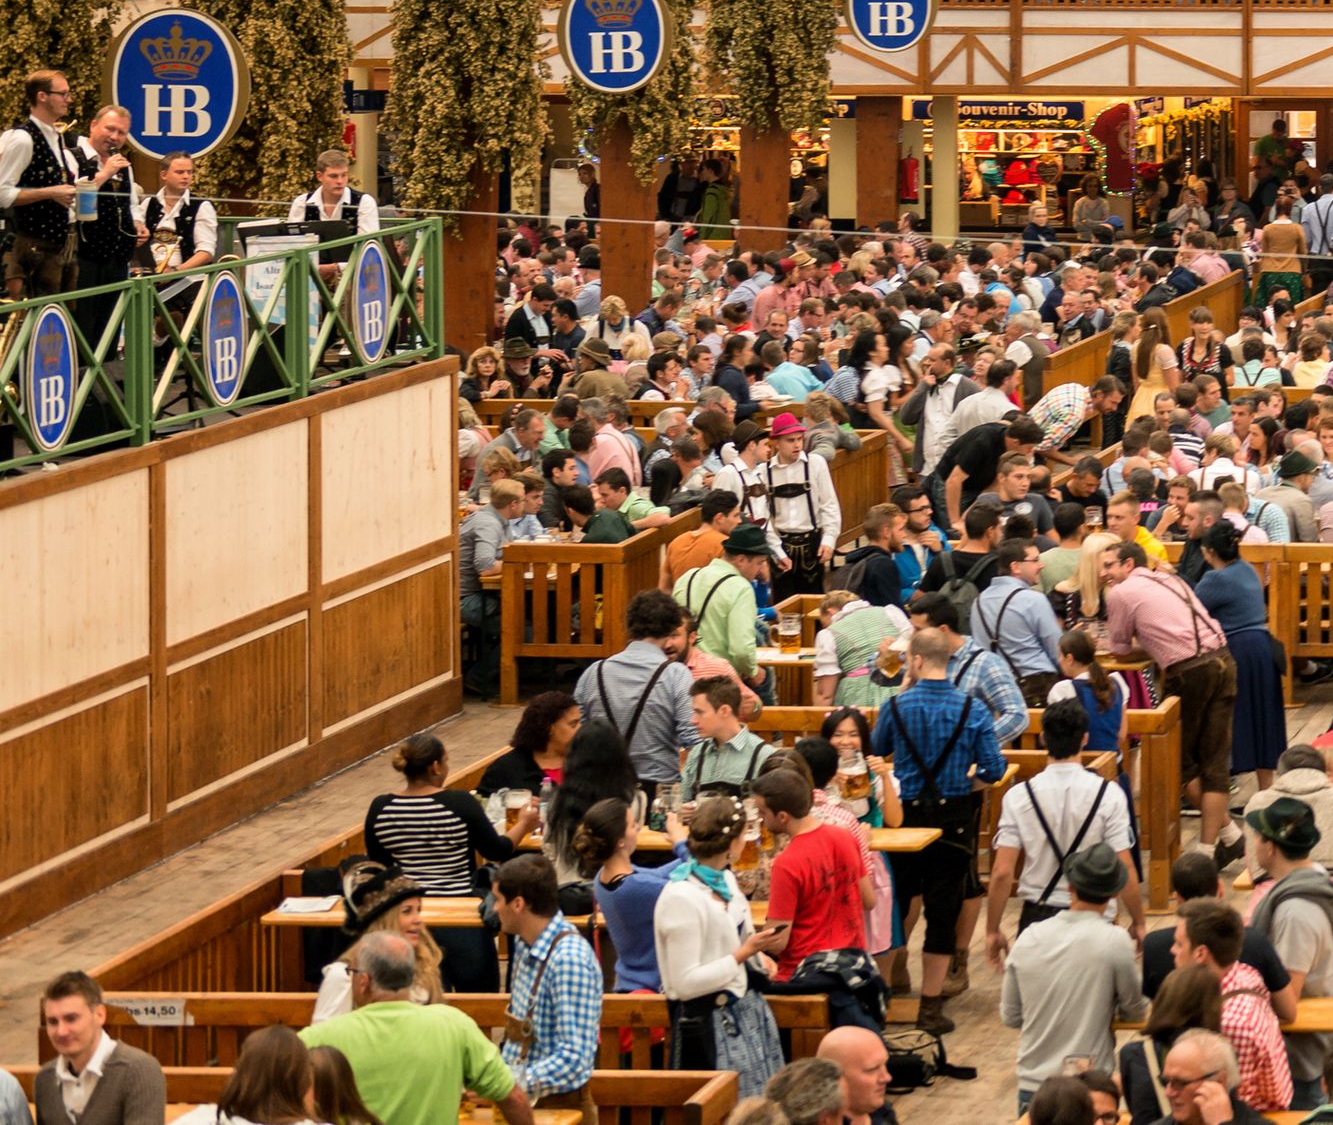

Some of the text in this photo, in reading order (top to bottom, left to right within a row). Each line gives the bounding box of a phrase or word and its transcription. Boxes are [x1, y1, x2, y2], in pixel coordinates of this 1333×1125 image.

[867, 1, 915, 37] HB
[588, 30, 645, 74] HB
[141, 84, 212, 138] HB
[363, 300, 383, 345] HB
[214, 336, 238, 384] HB
[39, 374, 66, 427] HB
[143, 1006, 176, 1016] 14,50
